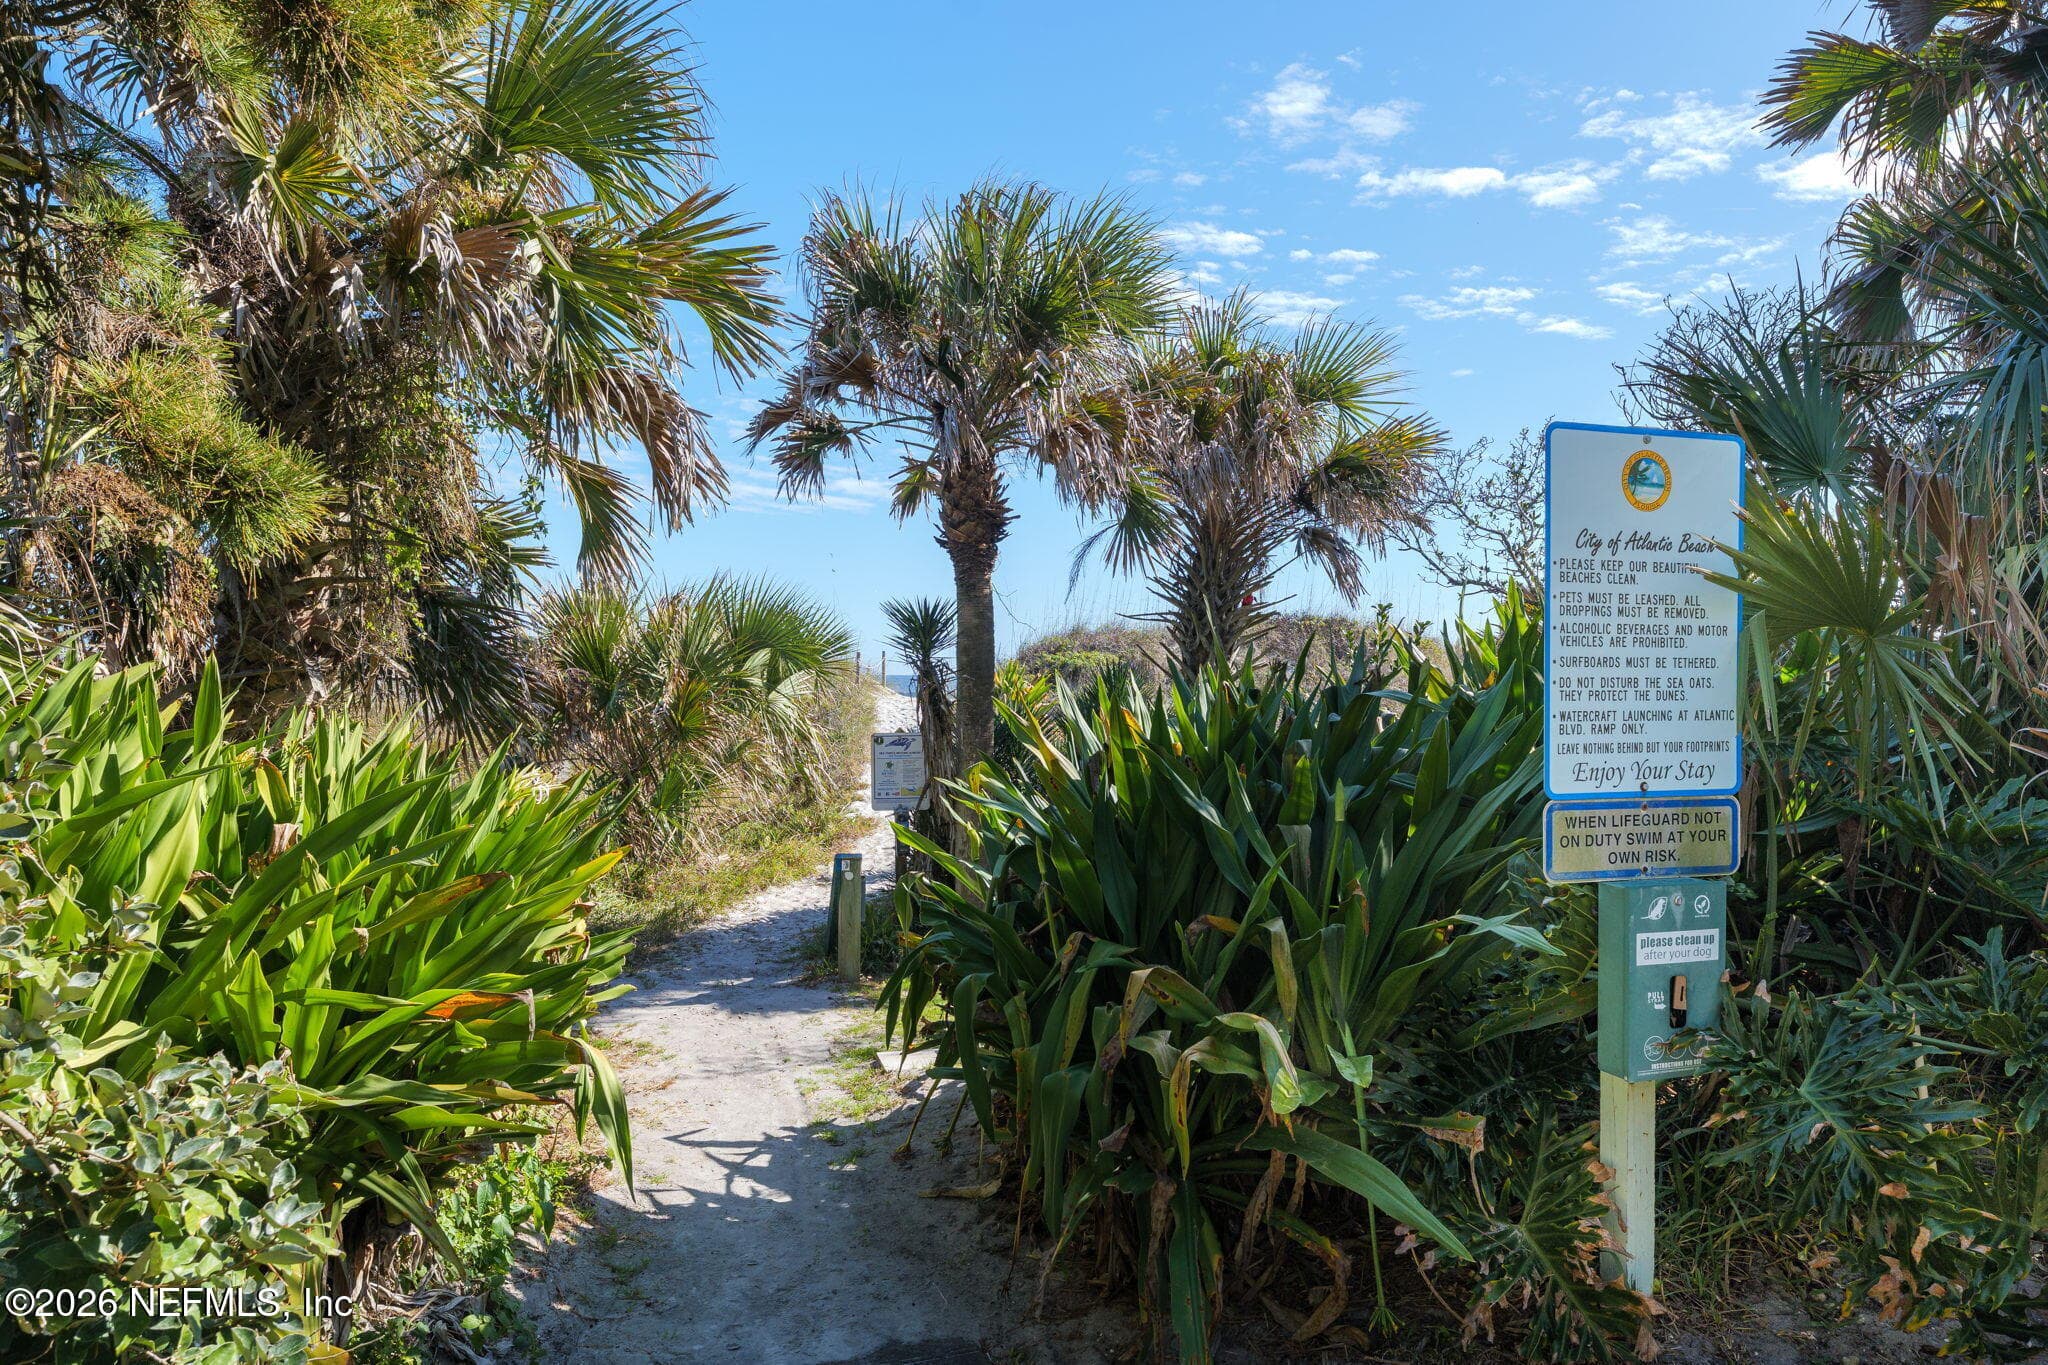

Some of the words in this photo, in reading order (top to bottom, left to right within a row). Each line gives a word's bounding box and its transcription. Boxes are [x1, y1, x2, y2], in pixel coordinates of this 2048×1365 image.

[1576, 528, 1602, 556] City
[1608, 531, 1623, 556] of
[1624, 531, 1673, 552] Atlantic
[1678, 533, 1716, 553] Beach
[1560, 559, 1595, 570] PLEASE
[1601, 560, 1623, 571] KEEP
[1629, 561, 1647, 572] OUR
[1560, 572, 1601, 583] BEACHES
[1608, 574, 1639, 585] CLEAN.
[1560, 592, 1582, 603] PETS
[1588, 593, 1612, 604] MUST
[1619, 594, 1629, 604] BE
[1635, 594, 1678, 606] LEASHED.
[1684, 595, 1700, 606] ALL
[1560, 605, 1612, 617] DROPPINGS
[1617, 606, 1641, 618] MUST
[1648, 607, 1658, 618] BE
[1664, 607, 1708, 619] REMOVED.
[1560, 623, 1611, 635] ALCOHOLIC
[1617, 624, 1669, 635] BEVERAGES
[1675, 625, 1693, 636] AND
[1698, 625, 1727, 637] MOTOR
[1560, 636, 1603, 647] VEHICLES
[1610, 637, 1627, 647] ARE
[1633, 637, 1687, 648] PROHIBITED.
[1560, 657, 1620, 668] SURFBOARDS
[1626, 657, 1649, 668] MUST
[1656, 658, 1667, 668] BE
[1673, 658, 1719, 669] TETHERED.
[1560, 677, 1571, 688] DO
[1577, 677, 1594, 688] NOT
[1601, 677, 1639, 688] DISTURB
[1645, 678, 1661, 688] THE
[1667, 678, 1683, 688] SEA
[1690, 678, 1714, 688] OATS.
[1560, 690, 1582, 701] THEY
[1589, 690, 1627, 701] PROTECT
[1635, 690, 1650, 701] THE
[1656, 690, 1688, 701] DUNES.
[1560, 710, 1617, 722] WATERCRAFT
[1623, 710, 1672, 721] LAUNCHING
[1678, 710, 1689, 721] AT
[1694, 709, 1735, 721] ATLANTIC
[1559, 724, 1586, 735] BLVD.
[1591, 724, 1616, 735] RAMP
[1622, 723, 1647, 734] ONLY.
[1558, 743, 1579, 754] LEAVE
[1583, 743, 1614, 754] NOTHING
[1617, 742, 1643, 753] BEHIND
[1647, 742, 1659, 753] BUT
[1664, 741, 1682, 752] YOUR
[1686, 741, 1730, 752] FOOTPRINTS
[1573, 760, 1625, 788] Enjoy
[1630, 759, 1673, 780] Your
[1675, 759, 1715, 786] Stay
[1566, 816, 1606, 829] WHEN
[1612, 813, 1689, 827] LIFEGUARD
[1694, 812, 1721, 824] NOT
[1560, 835, 1580, 848] ON
[1586, 833, 1621, 846] DUTY
[1626, 832, 1662, 845] SWIM
[1667, 831, 1684, 843] AT
[1689, 829, 1726, 842] YOUR
[1608, 851, 1640, 864] OWN
[1645, 850, 1680, 862] RISK.
[1640, 936, 1673, 949] please
[1675, 934, 1702, 946] clean
[1704, 934, 1715, 946] up
[1644, 950, 1667, 960] after
[1669, 950, 1690, 961] your
[1693, 946, 1712, 958] dog
